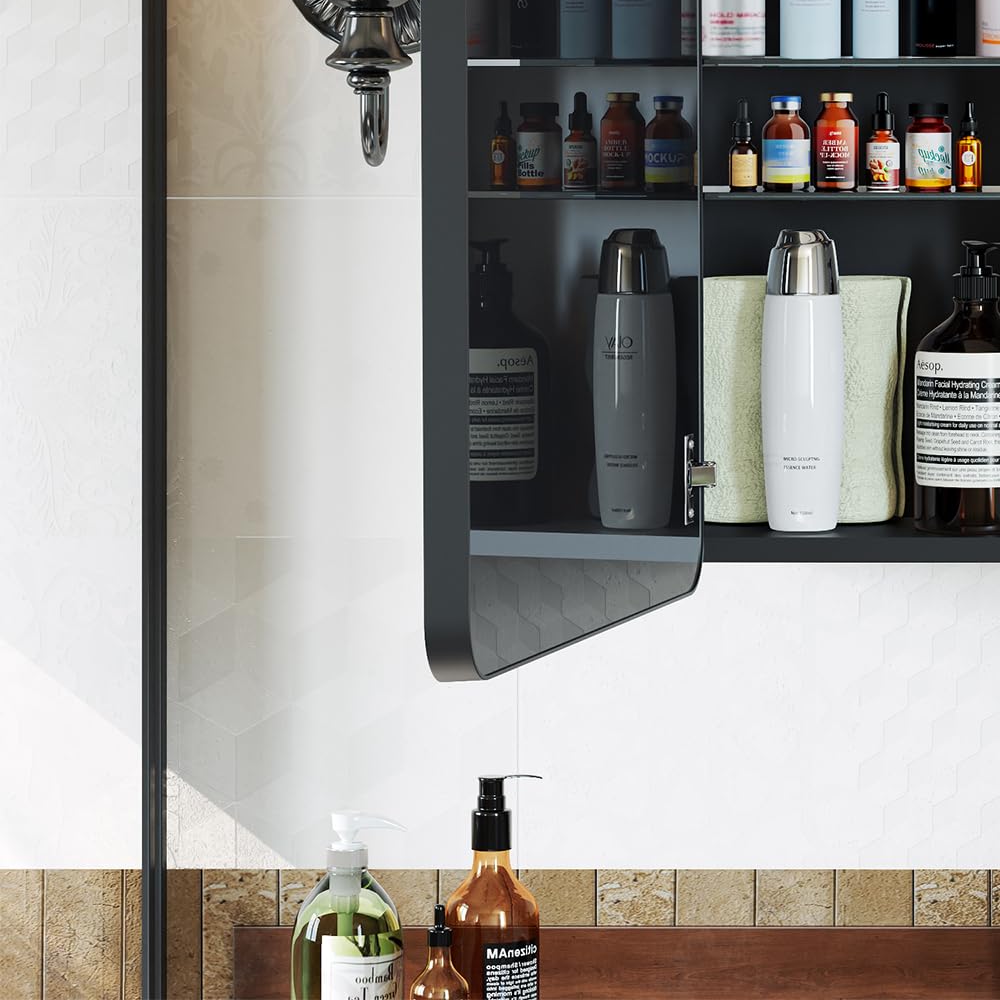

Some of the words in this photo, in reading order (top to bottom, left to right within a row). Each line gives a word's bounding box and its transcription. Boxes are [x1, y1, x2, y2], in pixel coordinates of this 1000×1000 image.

[951, 380, 980, 391] Hydrating
[929, 390, 957, 400] Hydratante
[958, 390, 963, 399] à
[963, 390, 970, 400] la
